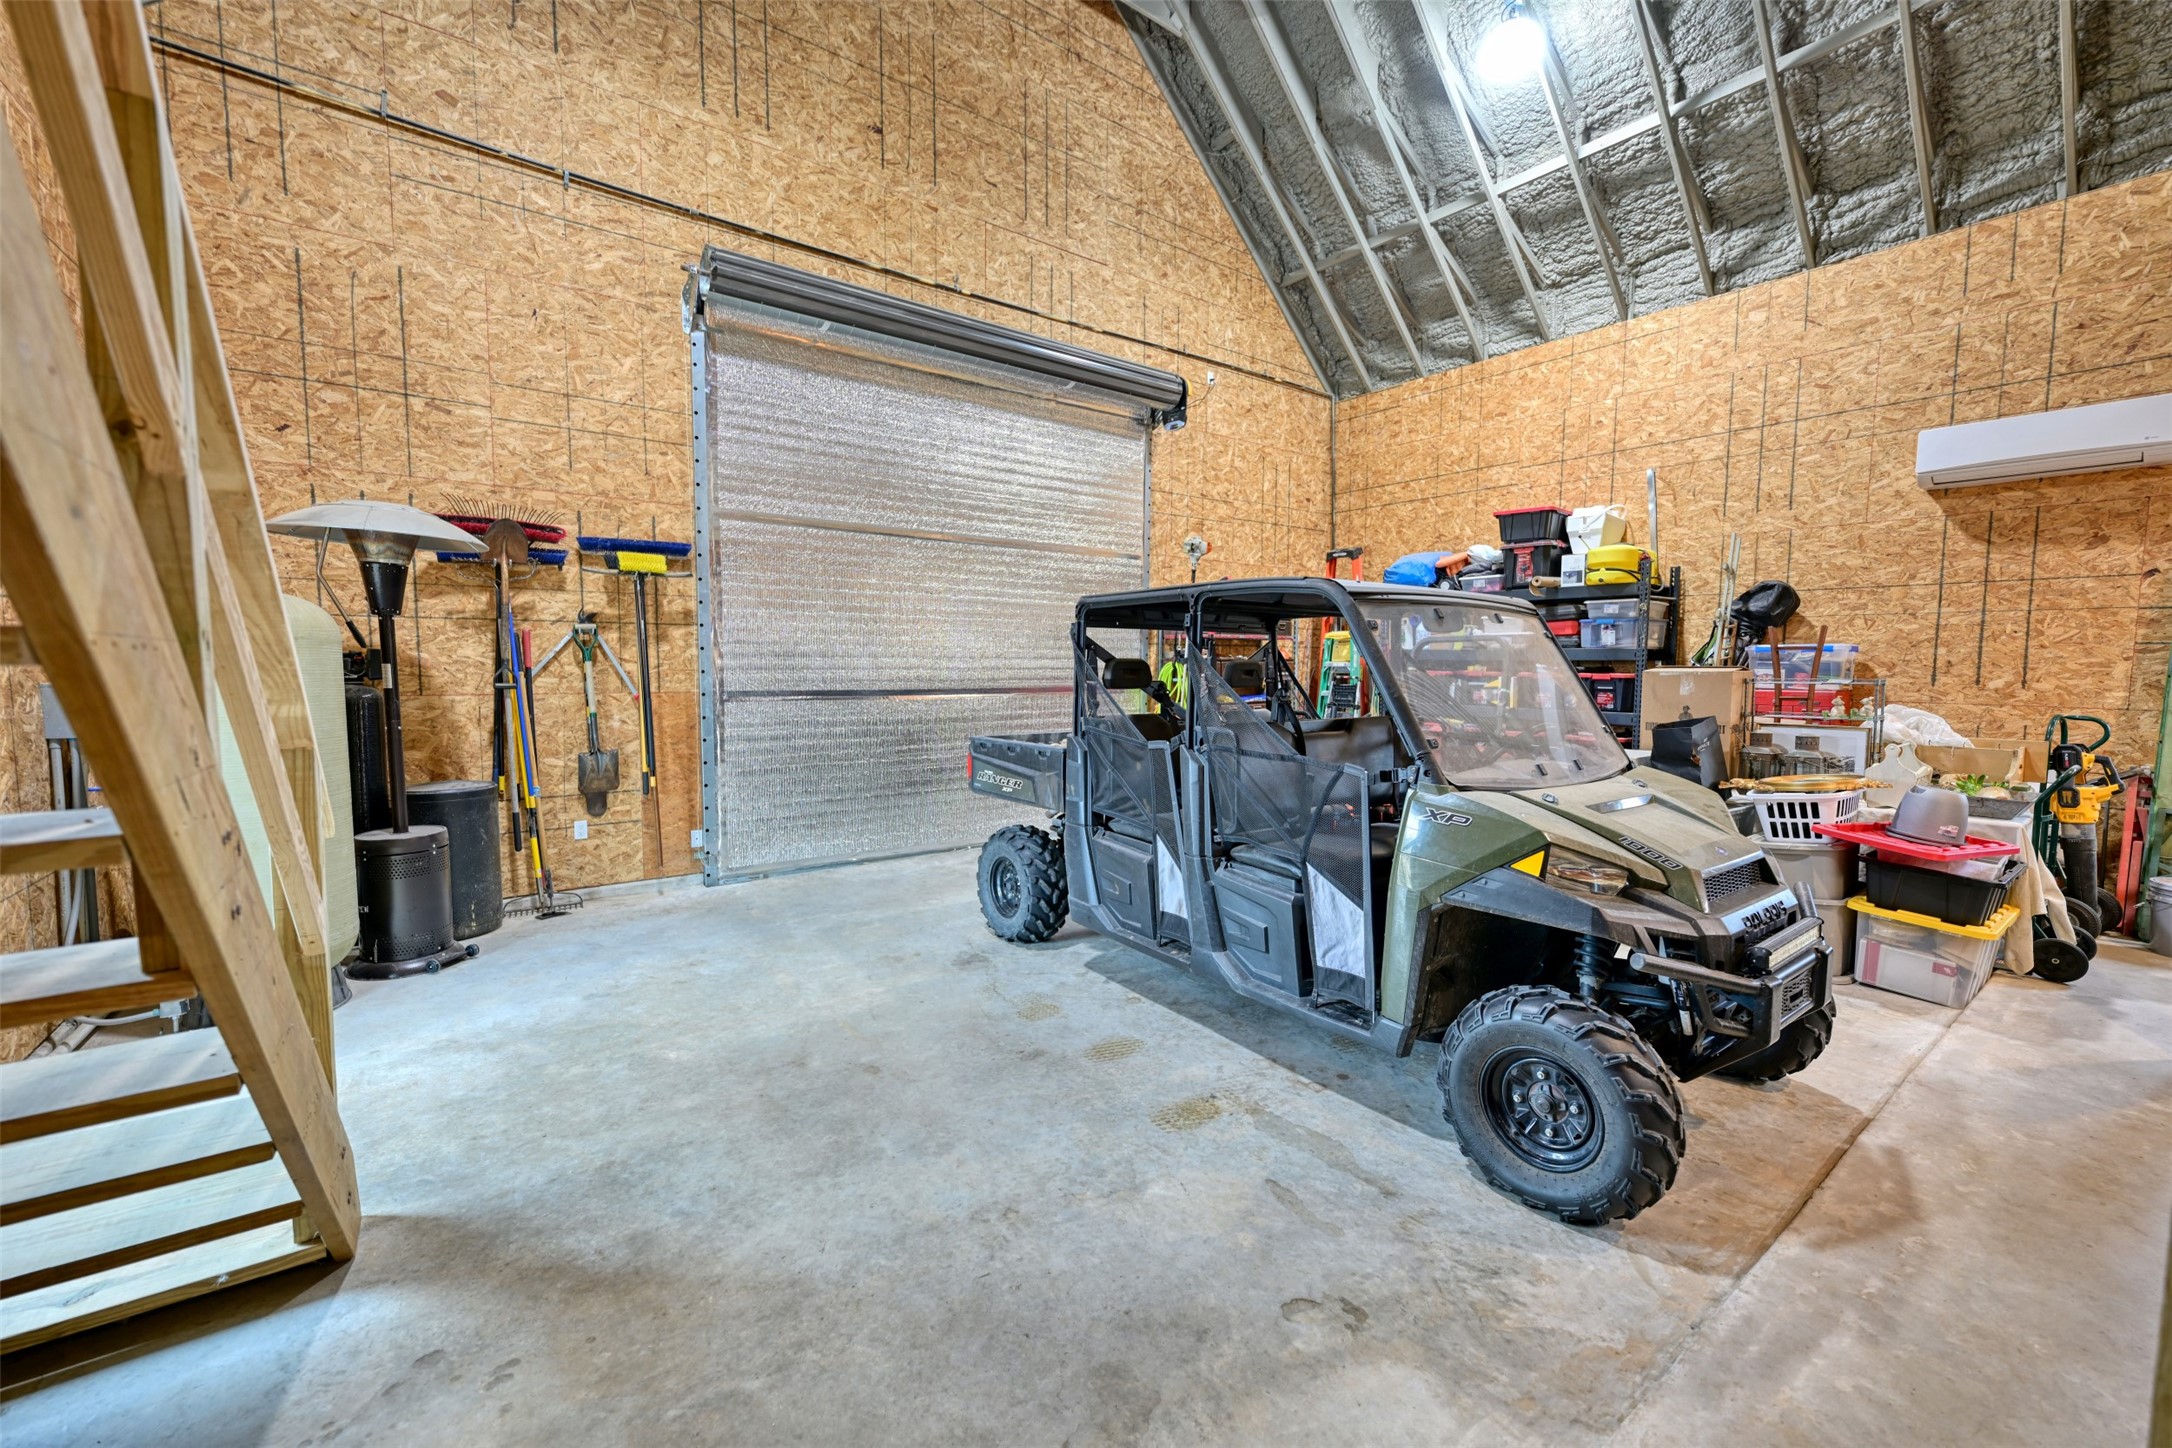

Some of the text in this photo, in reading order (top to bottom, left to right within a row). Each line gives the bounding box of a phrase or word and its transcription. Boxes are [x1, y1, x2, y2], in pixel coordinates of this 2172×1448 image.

[977, 771, 1023, 789] RANGER
[1417, 807, 1473, 826] XP
[1619, 836, 1683, 871] 1000
[1741, 901, 1787, 935] POLARIS
